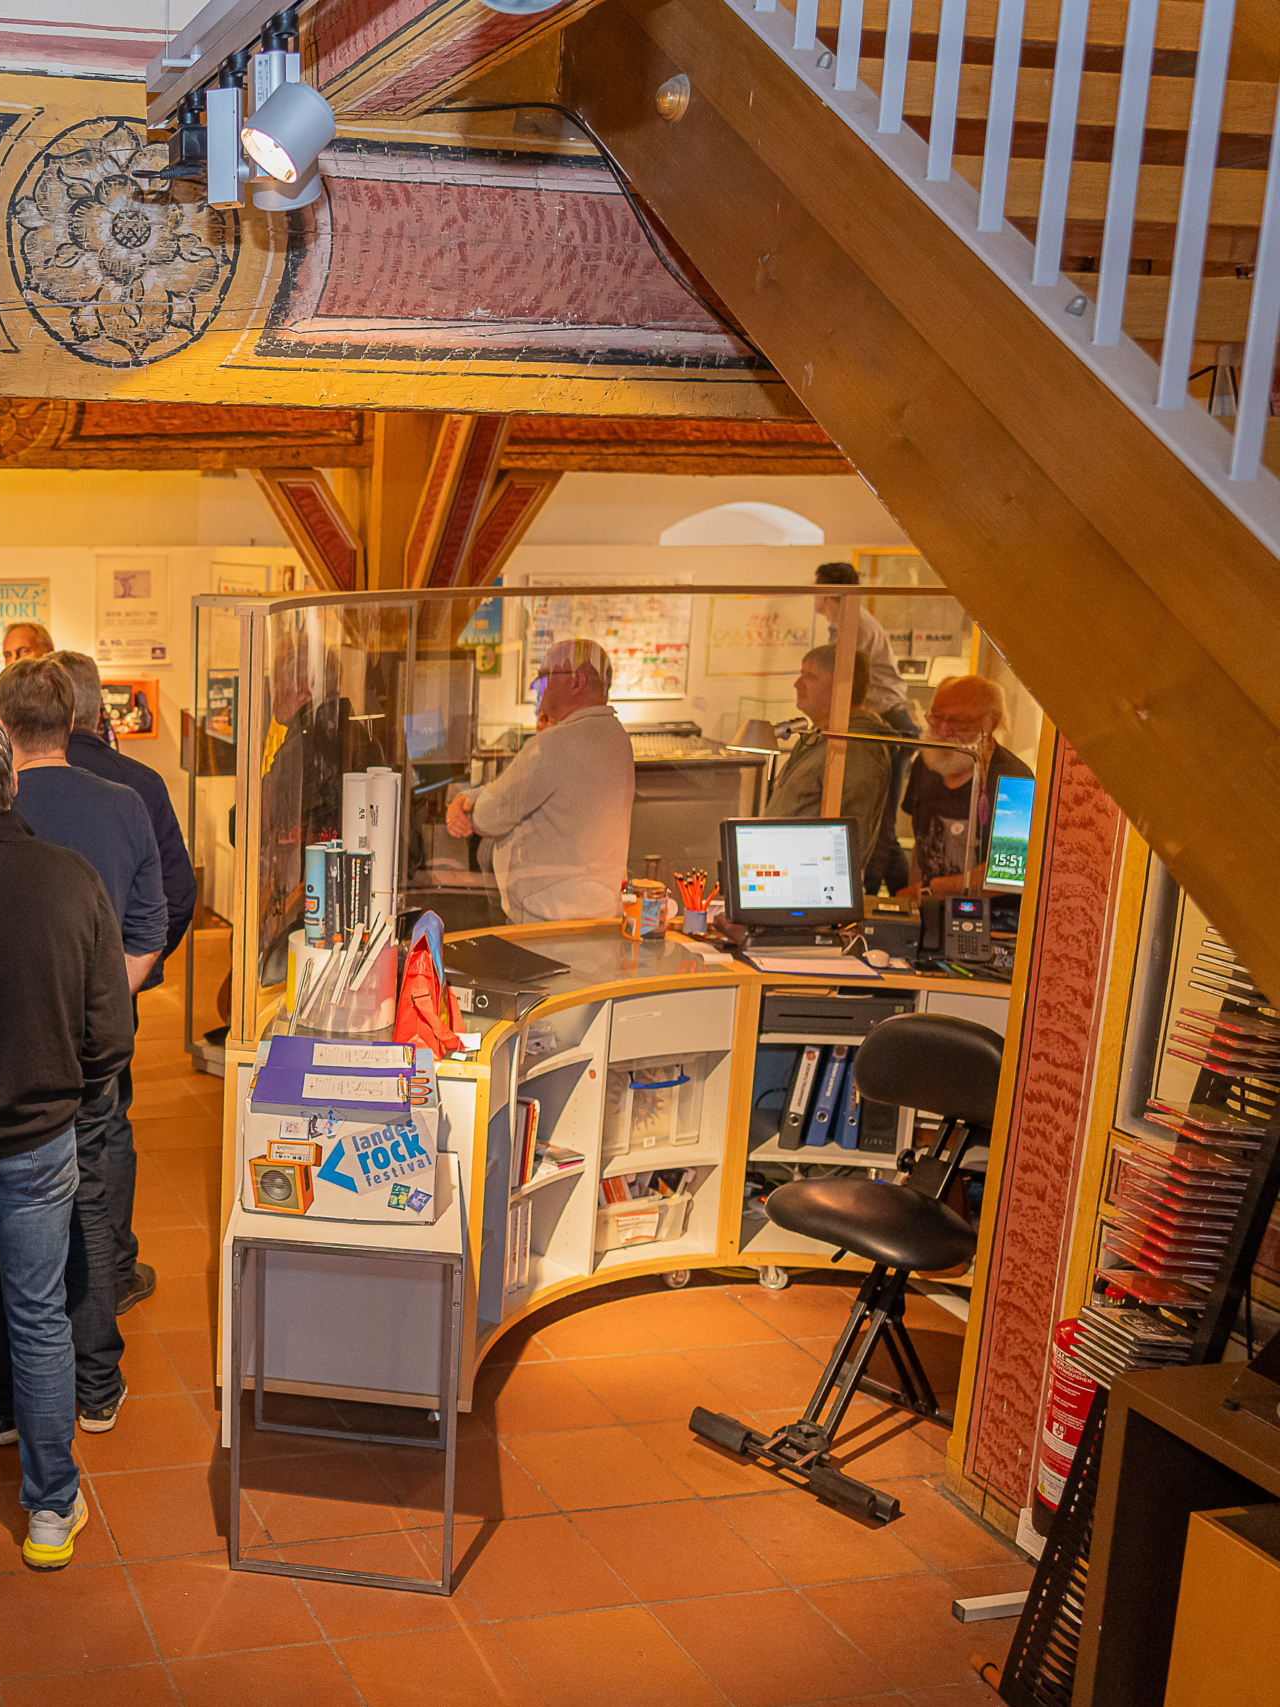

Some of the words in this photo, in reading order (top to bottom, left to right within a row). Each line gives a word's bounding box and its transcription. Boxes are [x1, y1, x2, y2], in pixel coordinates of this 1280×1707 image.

[993, 853, 1023, 867] 15:51
[351, 1118, 417, 1152] landes
[356, 1131, 428, 1176] rock
[365, 1153, 433, 1187] festival
